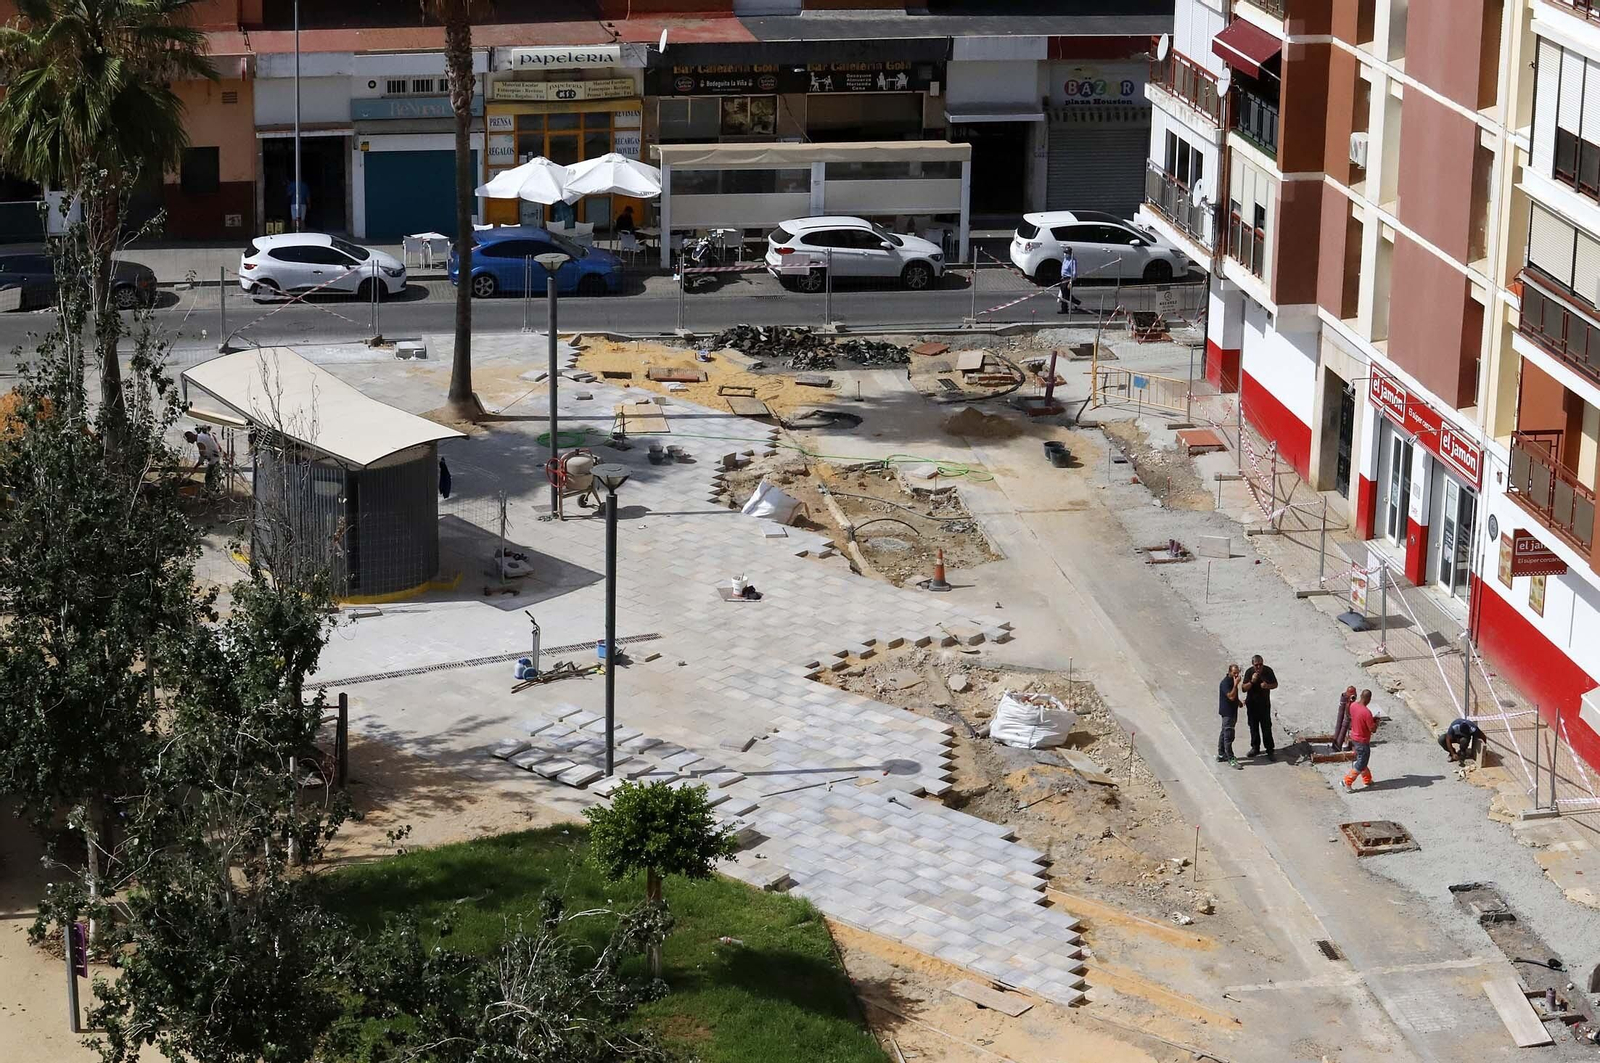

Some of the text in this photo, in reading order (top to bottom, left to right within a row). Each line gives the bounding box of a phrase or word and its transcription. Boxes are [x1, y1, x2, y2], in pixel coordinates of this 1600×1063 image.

[520, 52, 614, 65] PAPELERIA
[706, 80, 730, 88] Bodeguita
[489, 117, 512, 127] PRENSA
[488, 146, 515, 156] REGALOS
[1373, 377, 1403, 412] el jamón
[1443, 432, 1477, 471] el jamón
[1519, 540, 1529, 550] el
